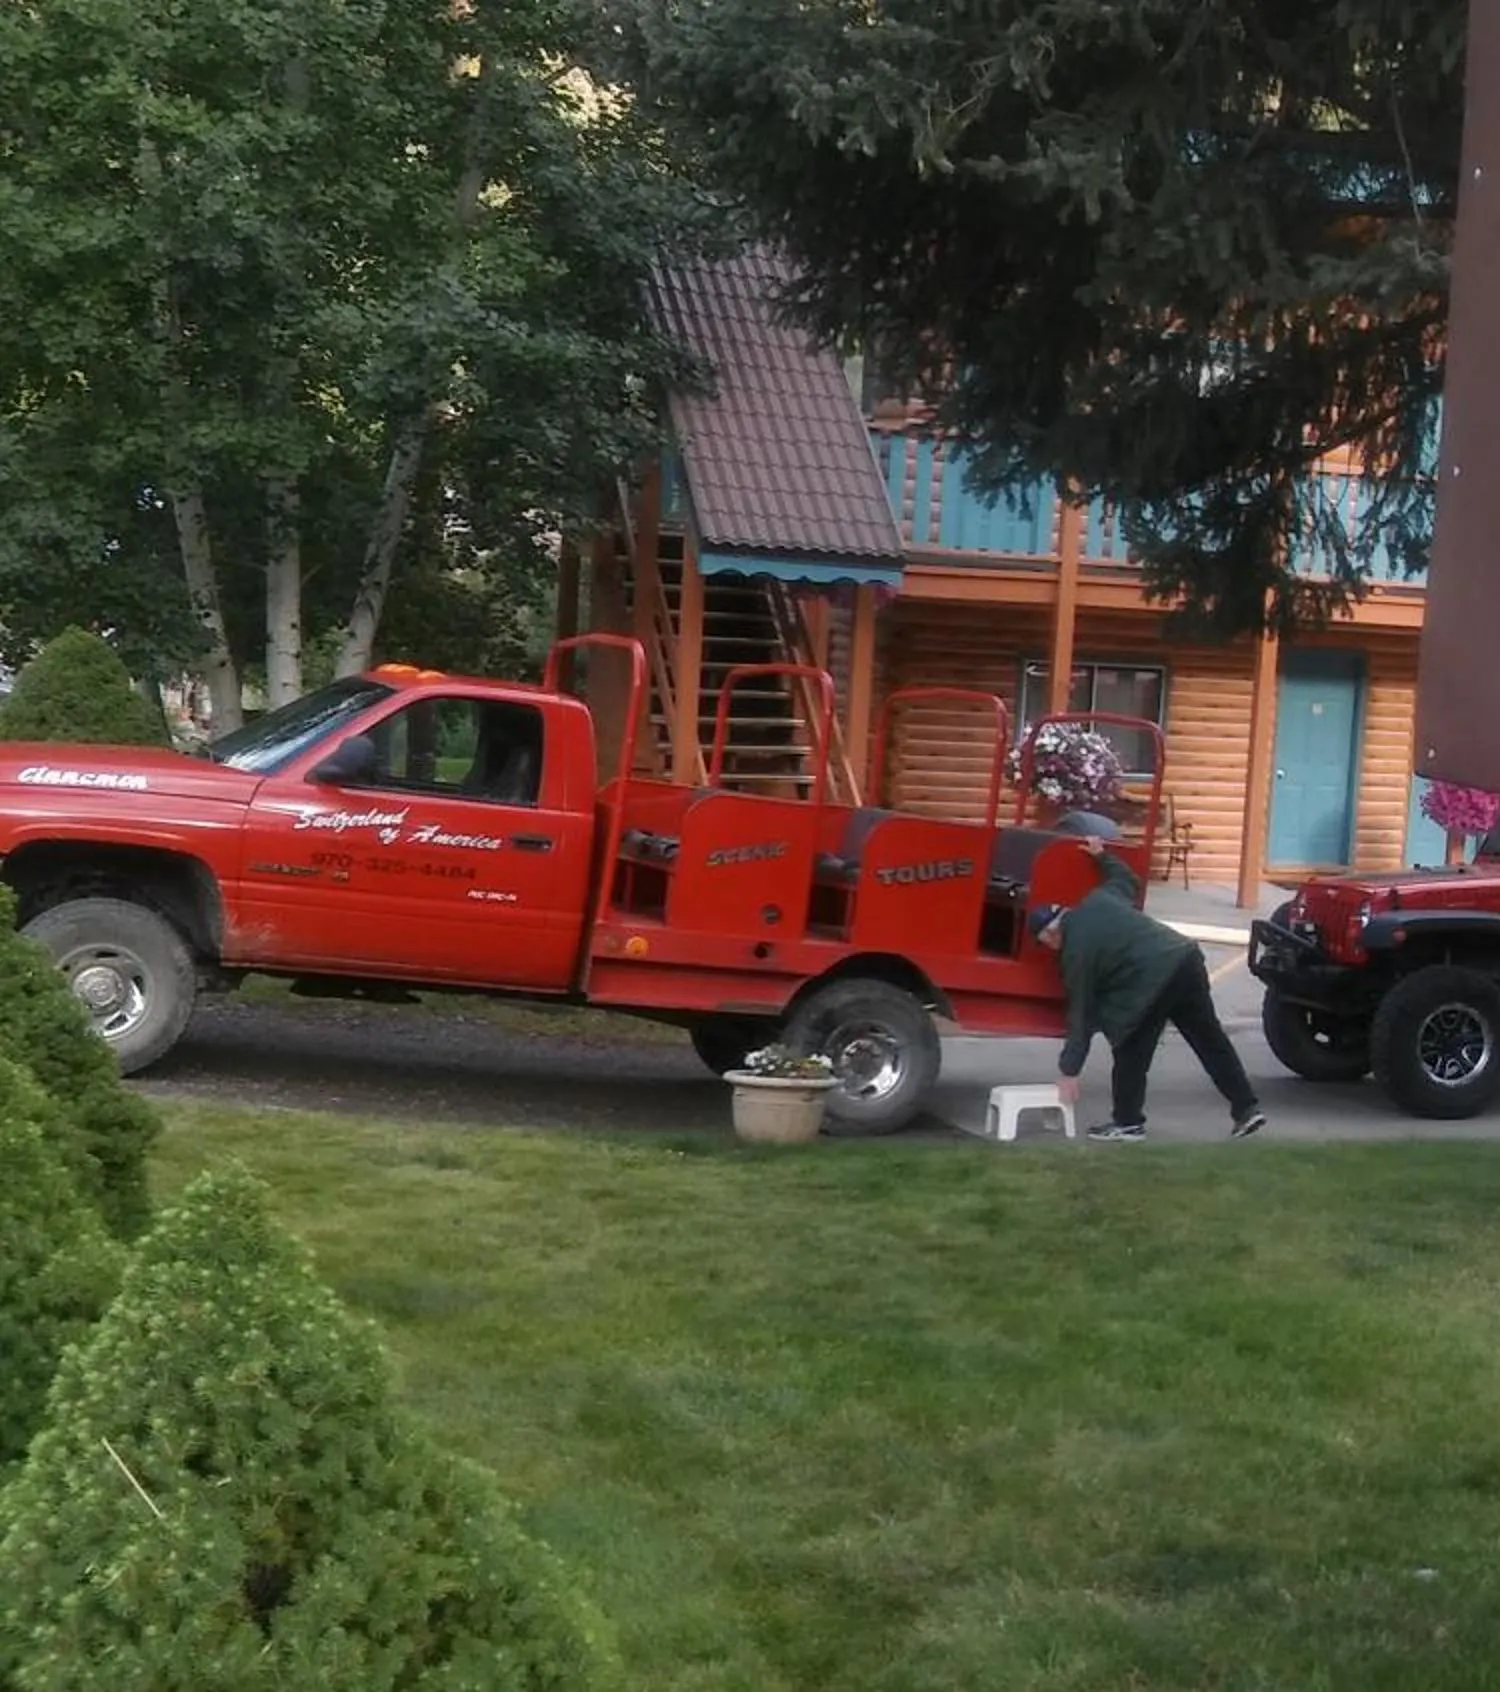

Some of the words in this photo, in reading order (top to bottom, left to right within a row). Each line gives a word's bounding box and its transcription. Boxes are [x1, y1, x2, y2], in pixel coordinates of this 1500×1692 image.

[294, 805, 410, 833] Switzerland
[378, 826, 401, 845] of
[405, 823, 503, 850] America
[877, 858, 974, 886] TOURS
